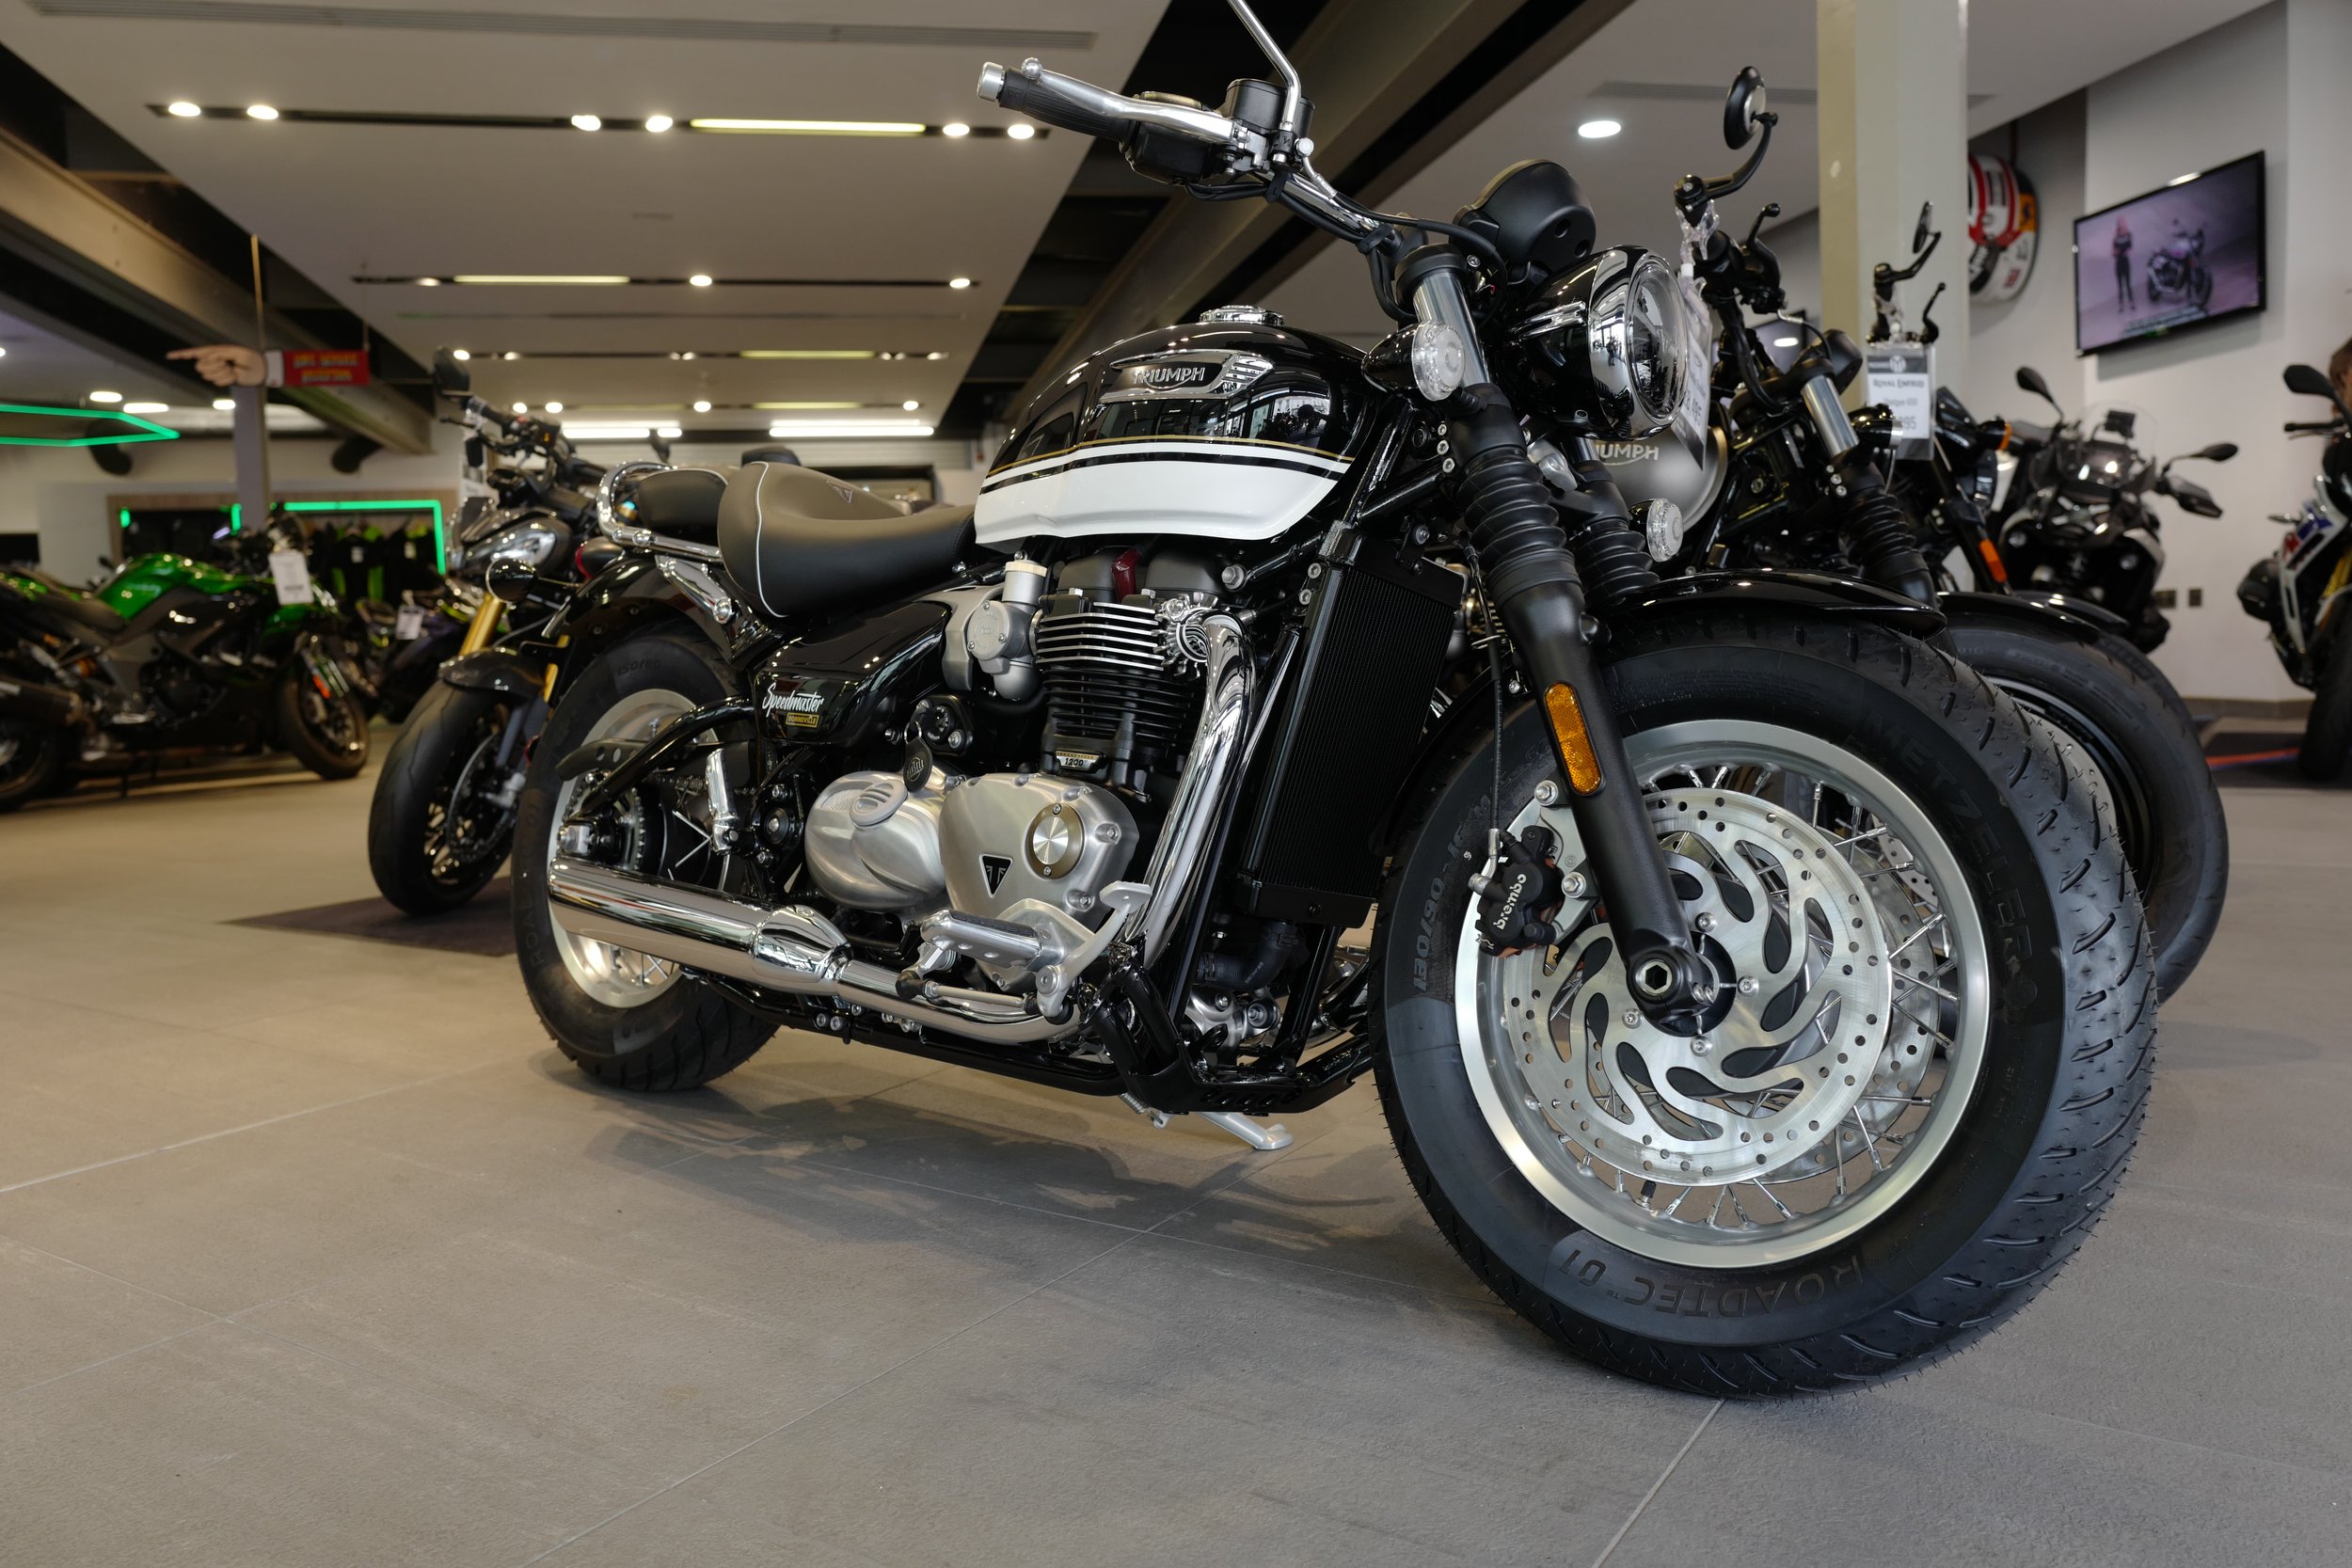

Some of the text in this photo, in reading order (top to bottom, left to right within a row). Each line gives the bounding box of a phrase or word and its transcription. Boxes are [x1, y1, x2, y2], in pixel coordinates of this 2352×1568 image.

[1133, 368, 1205, 385] TRIUMPH
[1596, 444, 1659, 461] IUMPH
[762, 682, 824, 718] Speedmaster
[1493, 873, 1527, 930] brembo
[1413, 877, 1446, 991] 130/90
